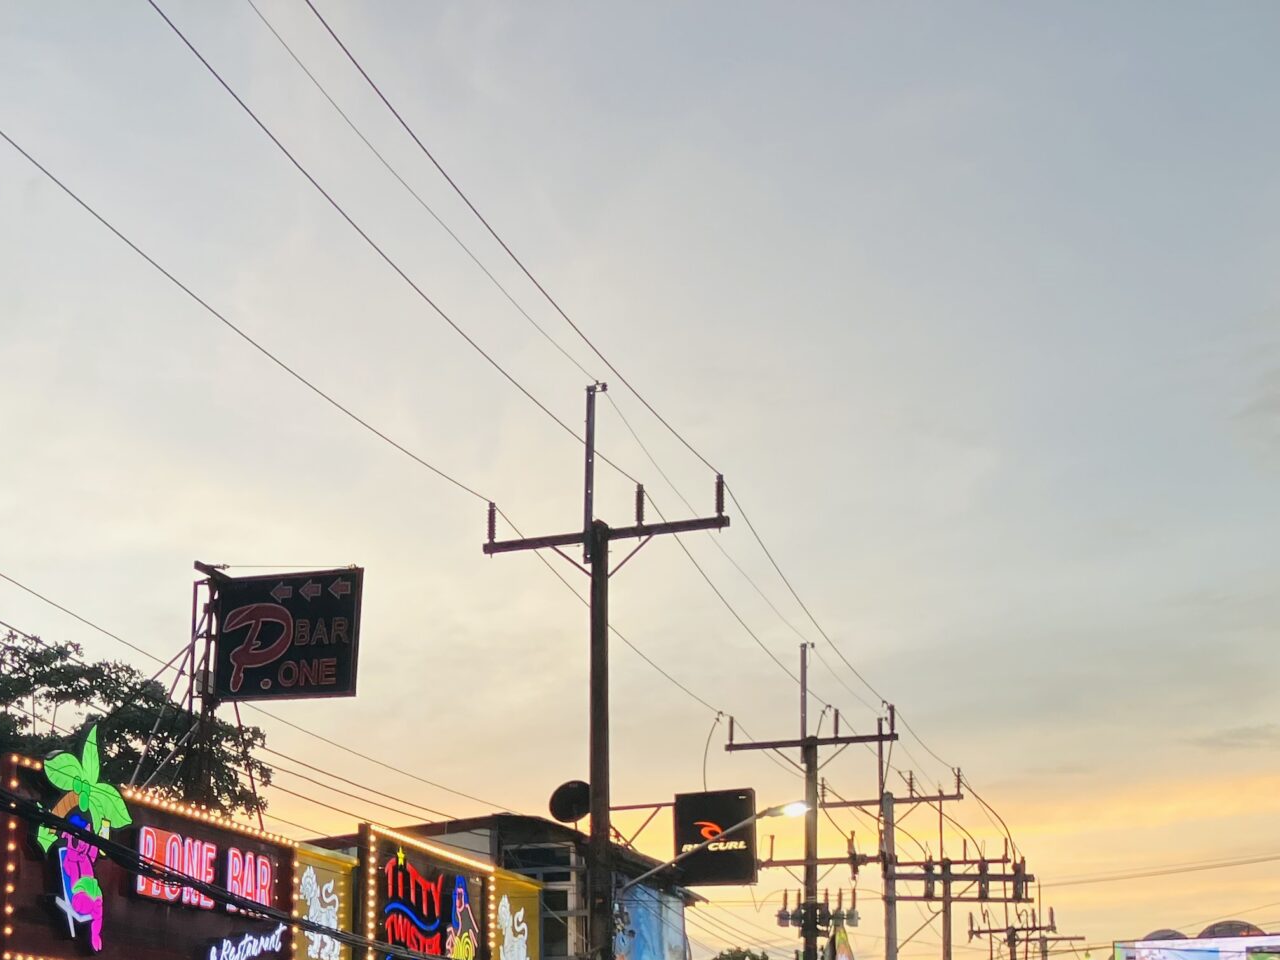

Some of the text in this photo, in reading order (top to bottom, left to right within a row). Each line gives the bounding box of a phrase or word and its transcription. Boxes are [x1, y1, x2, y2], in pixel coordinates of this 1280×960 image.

[294, 618, 349, 646] BAR
[707, 841, 747, 852] CURL
[226, 847, 272, 917] BAR
[385, 857, 444, 917] TITTY
